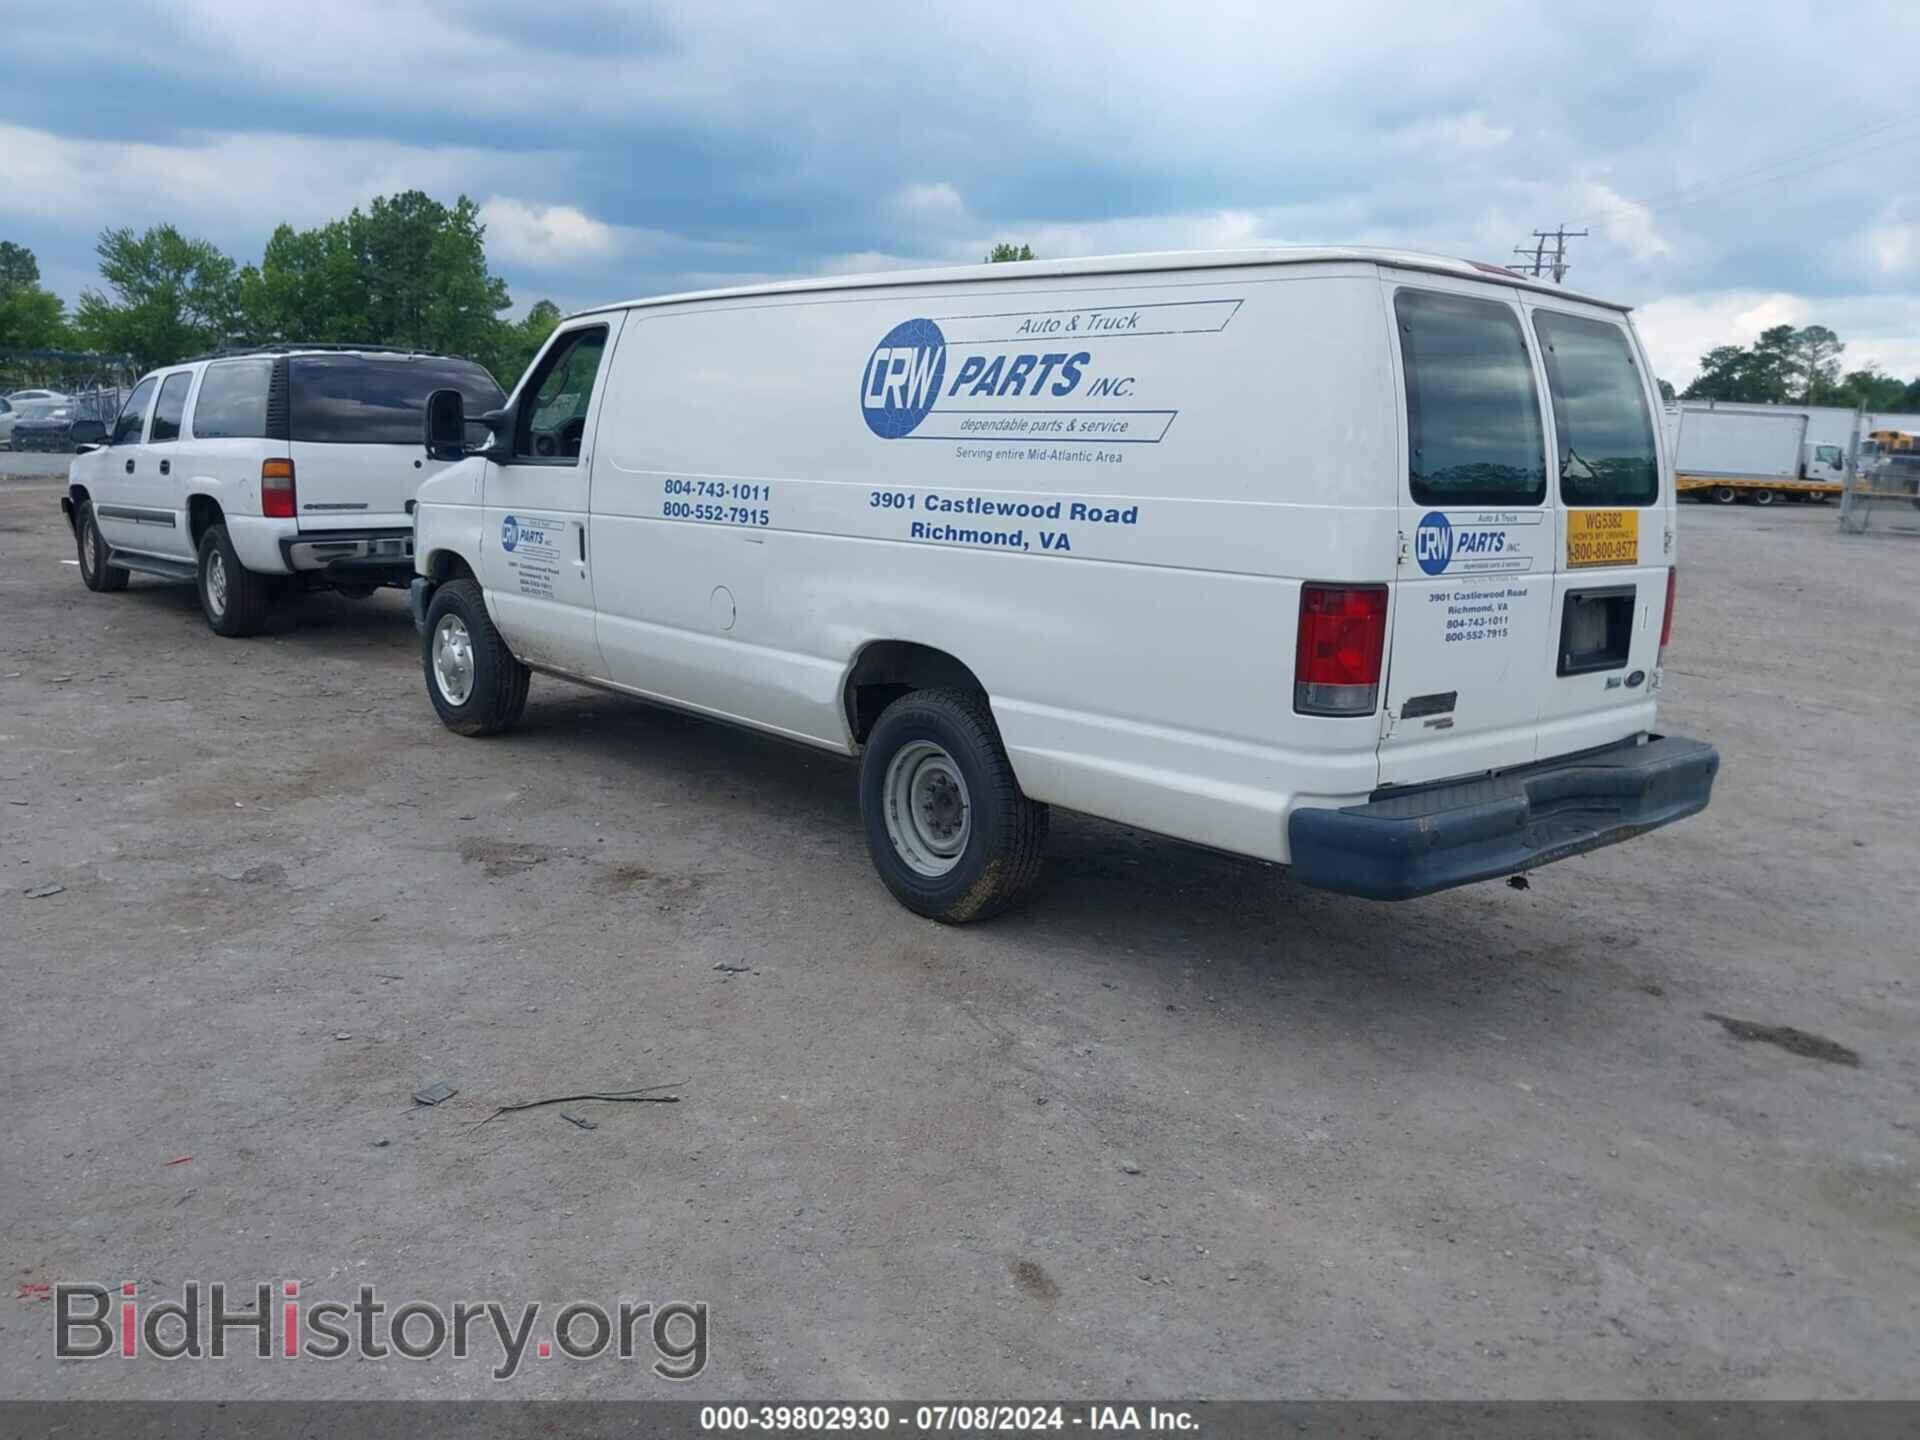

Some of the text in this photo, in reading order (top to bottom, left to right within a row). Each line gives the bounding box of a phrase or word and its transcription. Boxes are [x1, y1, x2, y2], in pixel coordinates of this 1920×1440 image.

[1017, 312, 1141, 335] Auto & Truck
[864, 346, 1135, 408] CRW PARTS INC.
[960, 418, 1129, 434] dependable parts & service
[956, 447, 1123, 463] Serving entire Mid-Atlantic Area
[869, 491, 1138, 524] 3901 Castlewood Road
[519, 529, 545, 545] PARTS
[910, 522, 1072, 551] Richmond, VA
[1418, 527, 1451, 560] CRW
[1456, 532, 1506, 553] PARTS
[1429, 588, 1528, 602] 3901 Castlewood Road
[1497, 602, 1508, 611] VA
[1446, 616, 1509, 629] 804-743-1011
[1445, 627, 1508, 642] 800-552-7915
